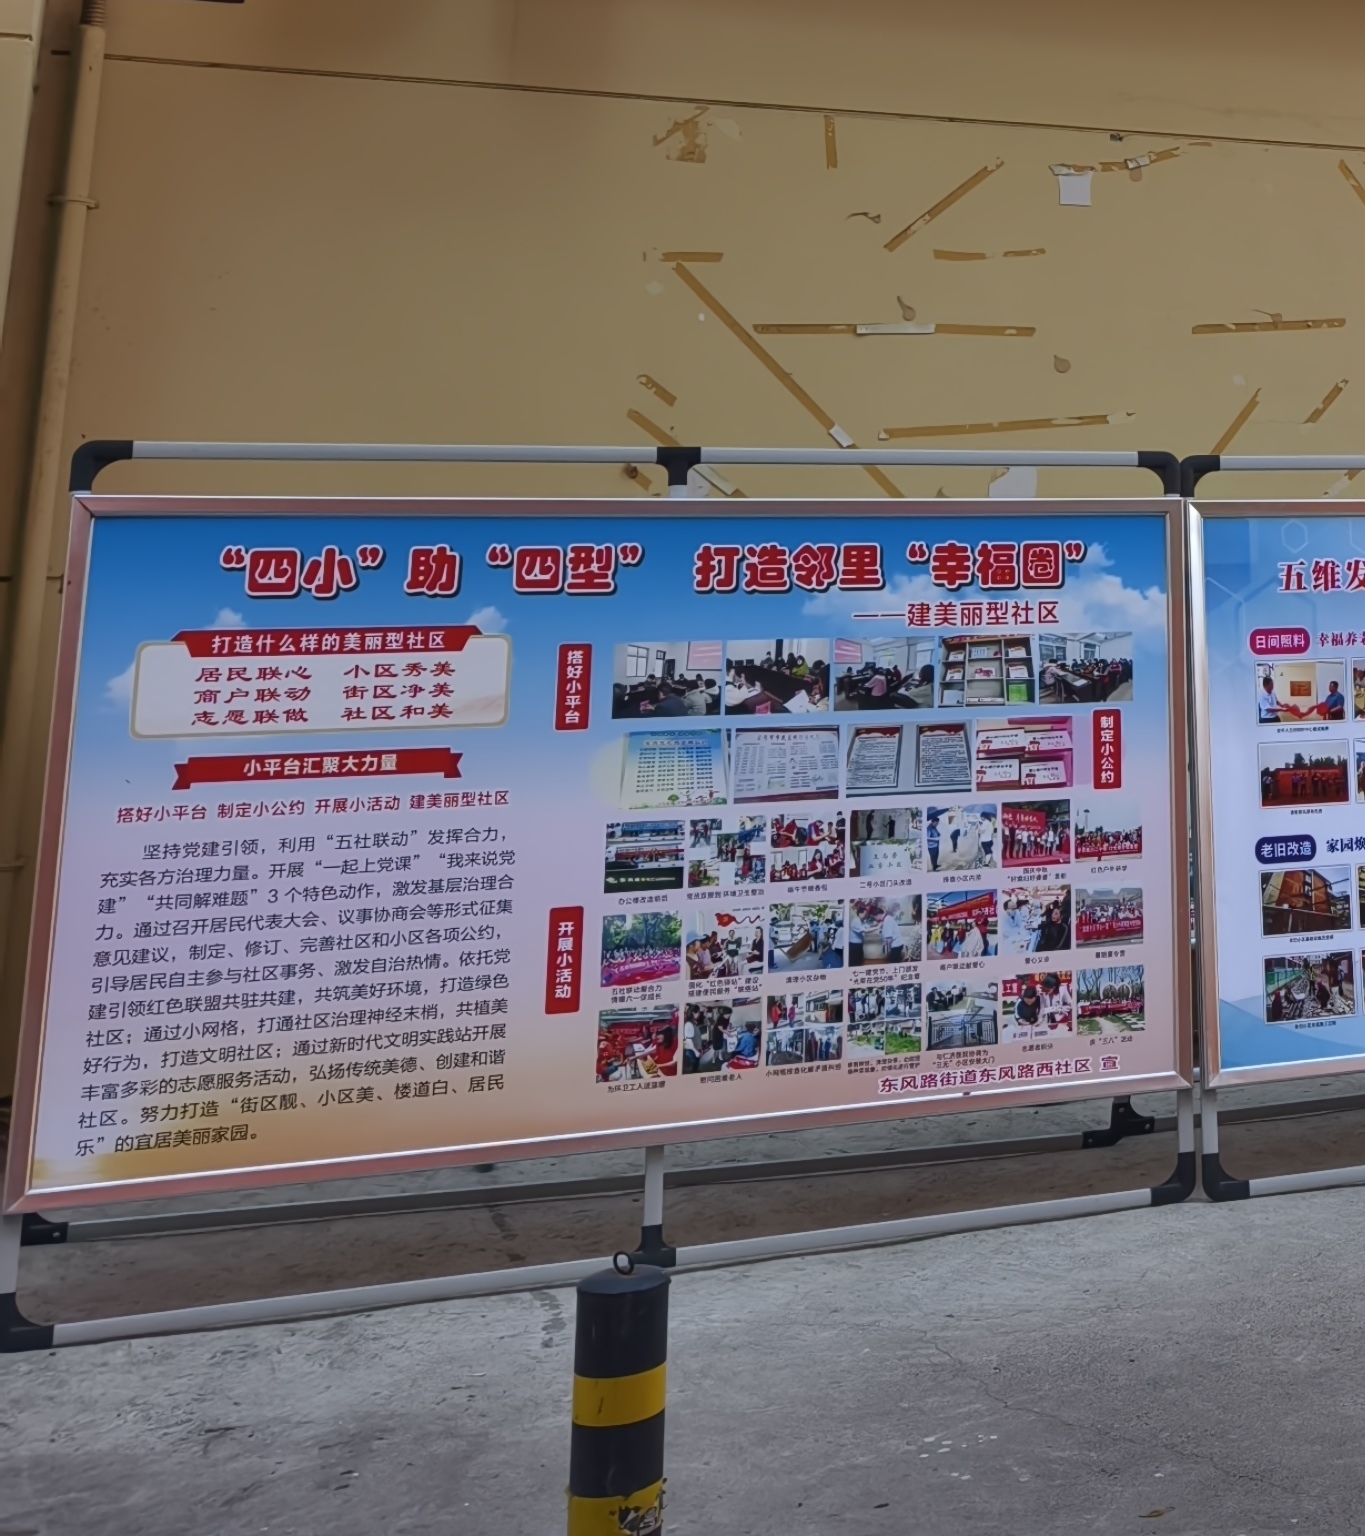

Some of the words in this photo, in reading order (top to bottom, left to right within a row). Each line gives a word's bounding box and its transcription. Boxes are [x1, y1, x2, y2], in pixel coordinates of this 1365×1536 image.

[211, 631, 446, 655] 打造什么样的美丽型社区
[1255, 634, 1305, 649] 日间照料
[195, 666, 313, 683] 居民联心
[343, 660, 456, 679] 小区秀美
[193, 686, 312, 705] 商户联动
[342, 682, 455, 700] 街区净美
[564, 650, 584, 725] 搭好小平台
[191, 708, 309, 726] 志愿联做
[340, 703, 454, 721] 社区和美
[1100, 715, 1115, 784] 制定小公约
[243, 754, 398, 777] 小平台汇聚大力量
[116, 804, 207, 825] 搭好小平台
[217, 799, 305, 819] 制定小公约
[314, 795, 401, 815] 开展小活动
[409, 790, 510, 810] 建美丽型社区
[1260, 840, 1312, 858] 老旧改造
[554, 921, 575, 1000] 开展小活动
[878, 1058, 1091, 1094] 东风路街道东风路西社区
[1100, 1055, 1120, 1072] 宣
